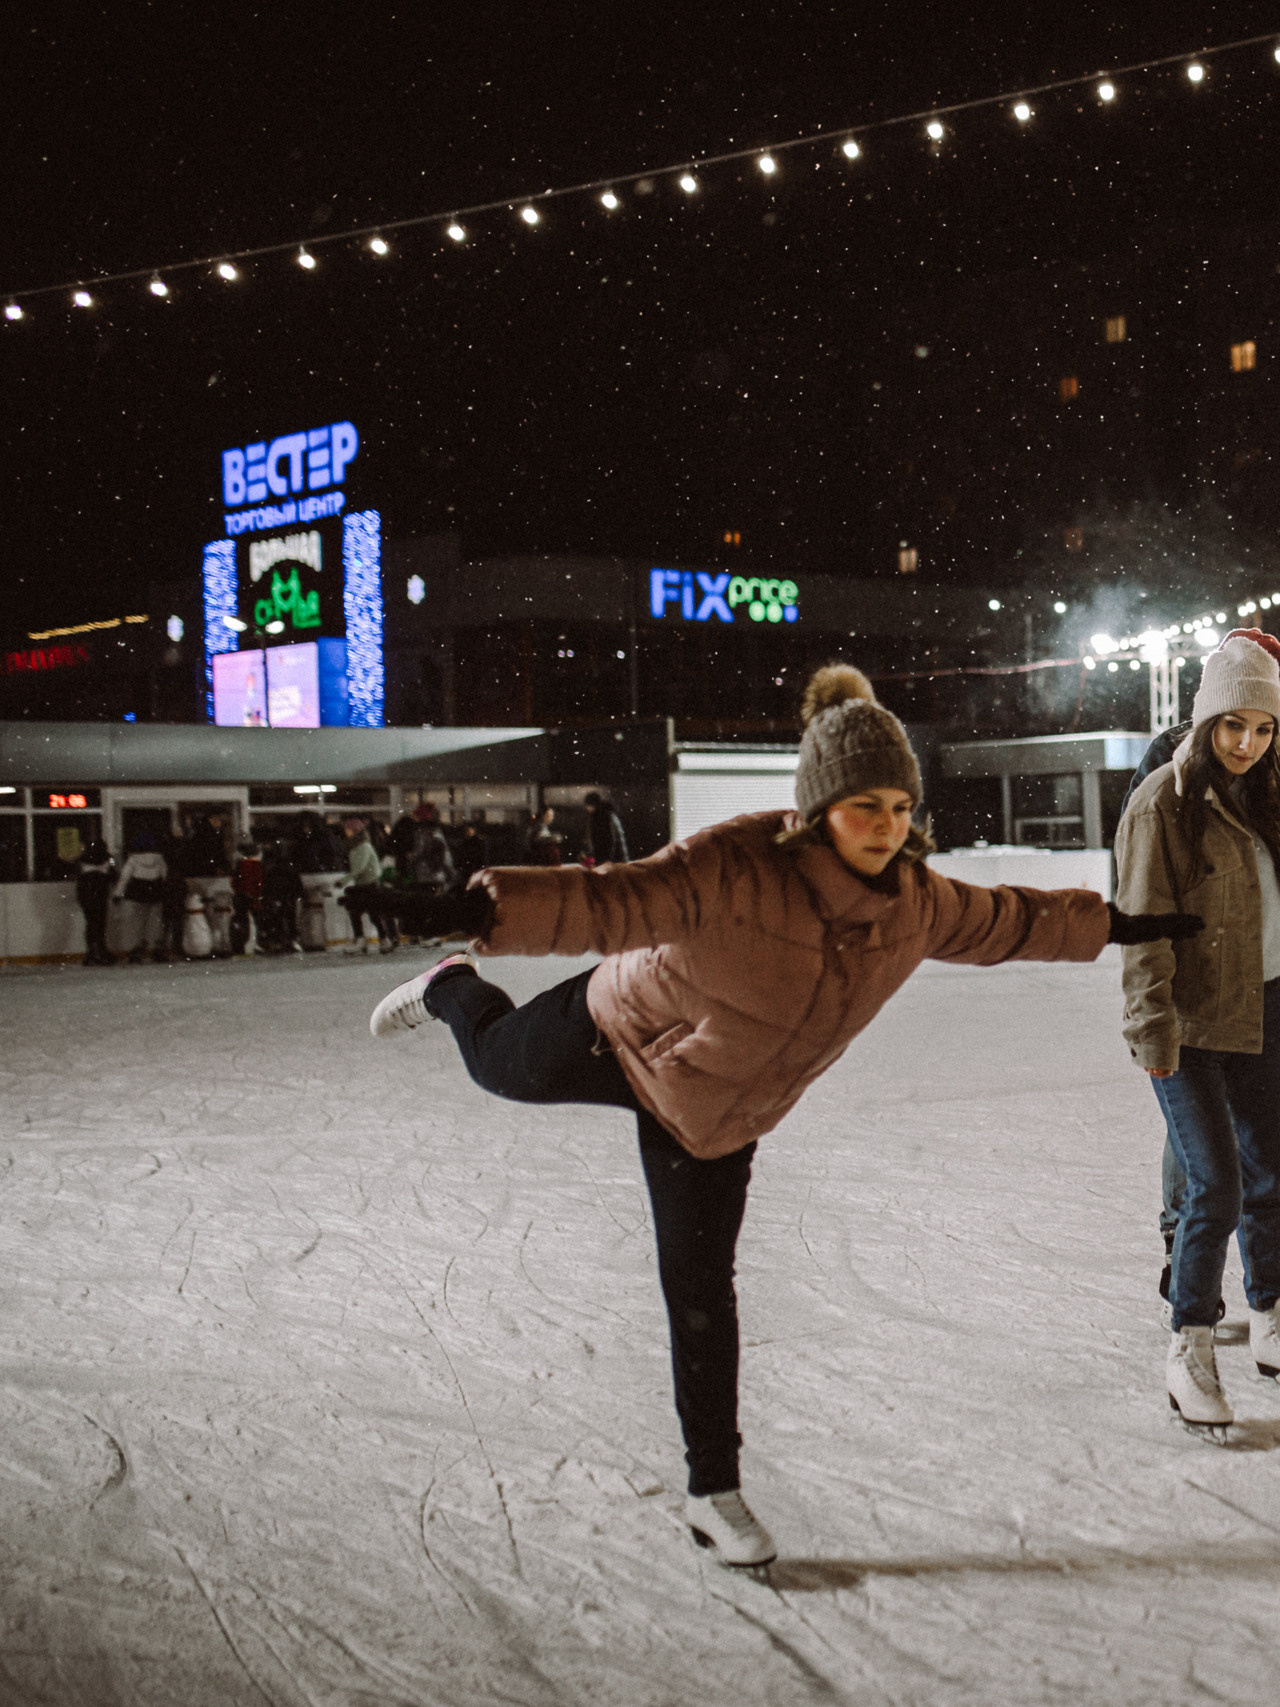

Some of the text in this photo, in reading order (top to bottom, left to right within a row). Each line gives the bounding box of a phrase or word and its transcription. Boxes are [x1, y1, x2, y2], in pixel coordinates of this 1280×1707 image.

[222, 420, 359, 507] ВЕСТЕР
[224, 491, 346, 536] ТОРГОВЫЙ ЦЕНТР
